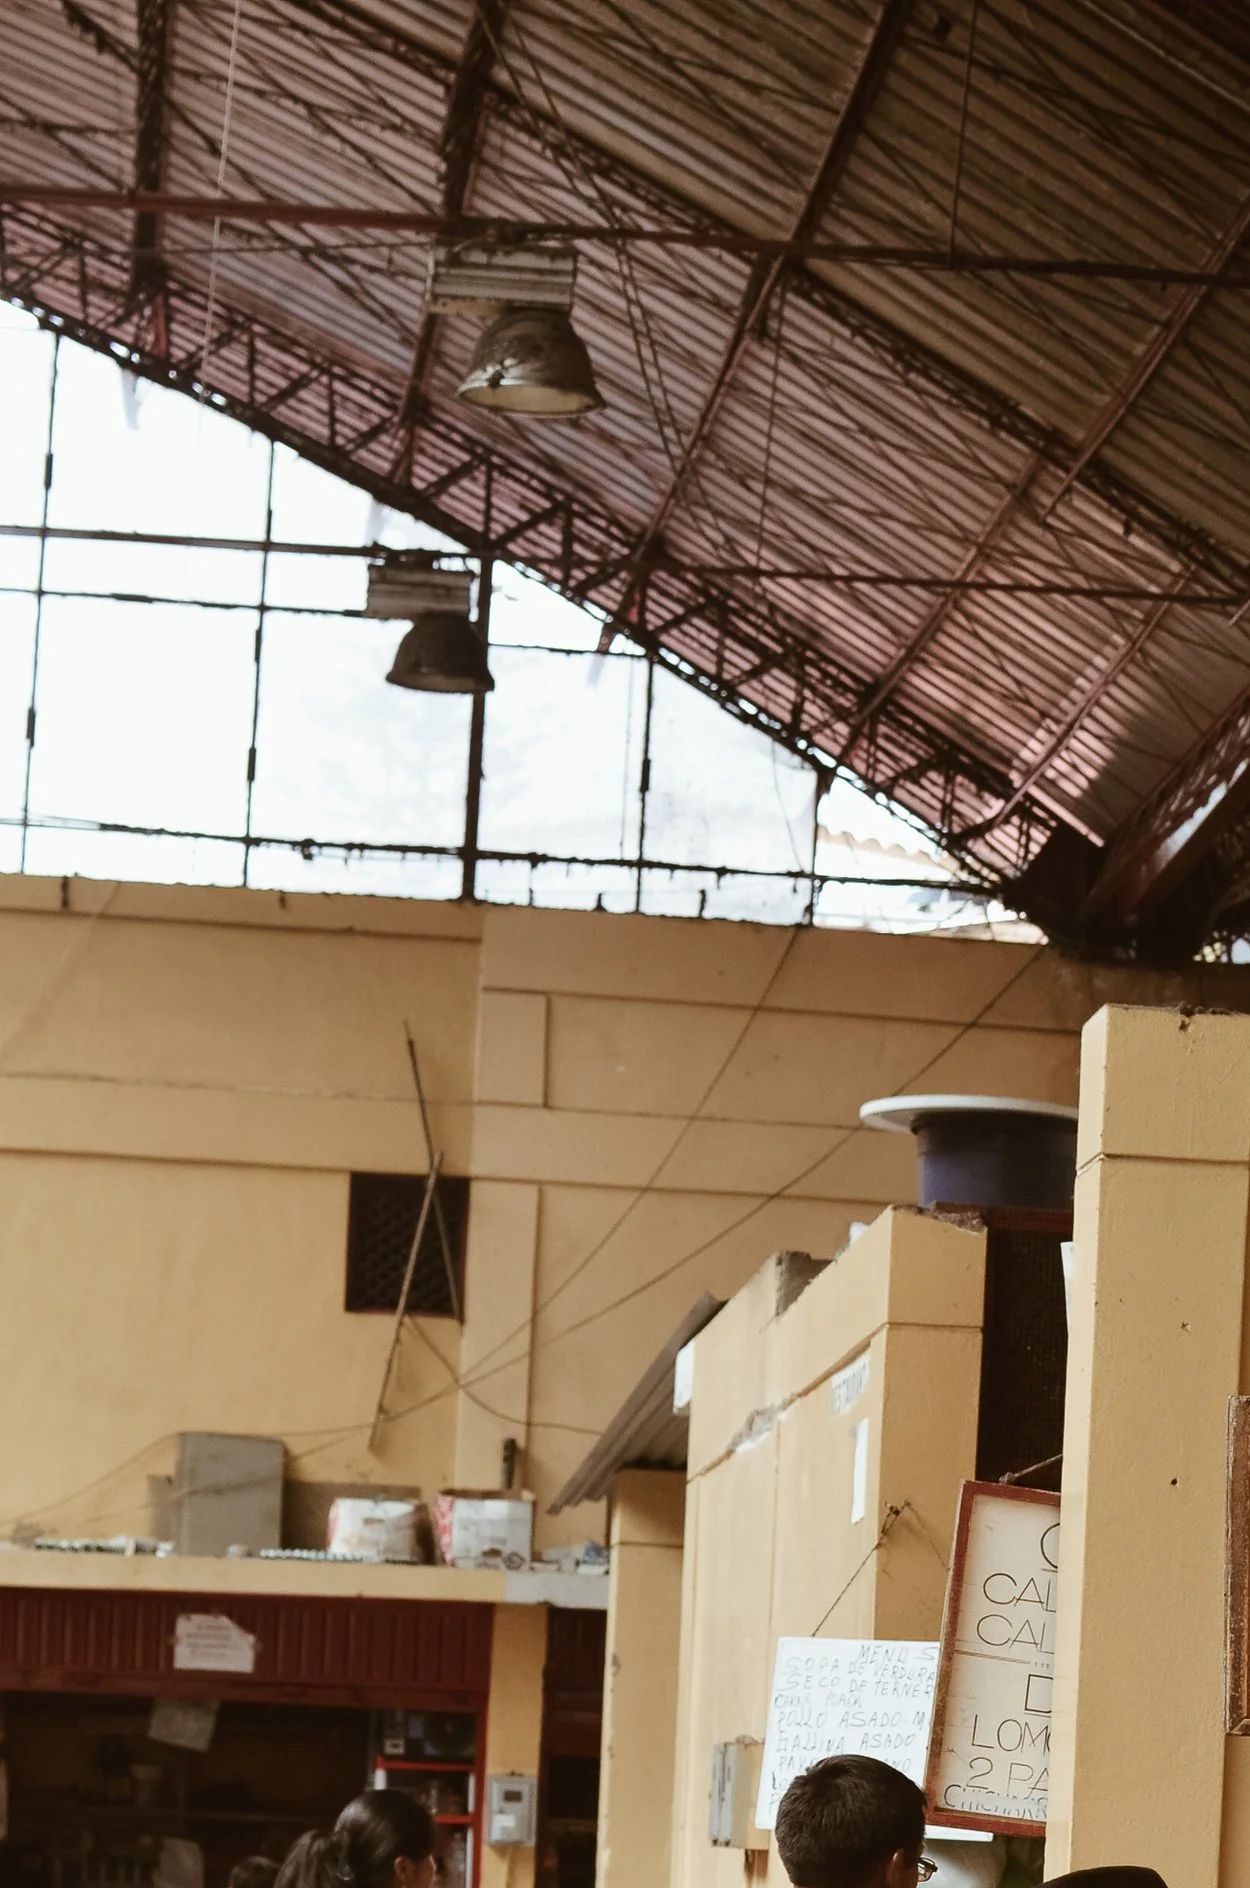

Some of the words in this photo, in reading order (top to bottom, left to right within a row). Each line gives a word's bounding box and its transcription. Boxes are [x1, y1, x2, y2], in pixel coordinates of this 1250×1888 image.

[983, 1572, 1057, 1613] CAL
[977, 1613, 1055, 1655] CAL
[780, 1656, 839, 1675] SOPA
[848, 1660, 867, 1676] DE
[776, 1673, 840, 1692] SECO
[850, 1678, 869, 1693] DE
[839, 1710, 901, 1729] ASADO
[859, 1731, 916, 1751] ASADO
[971, 1714, 1050, 1756] LOM
